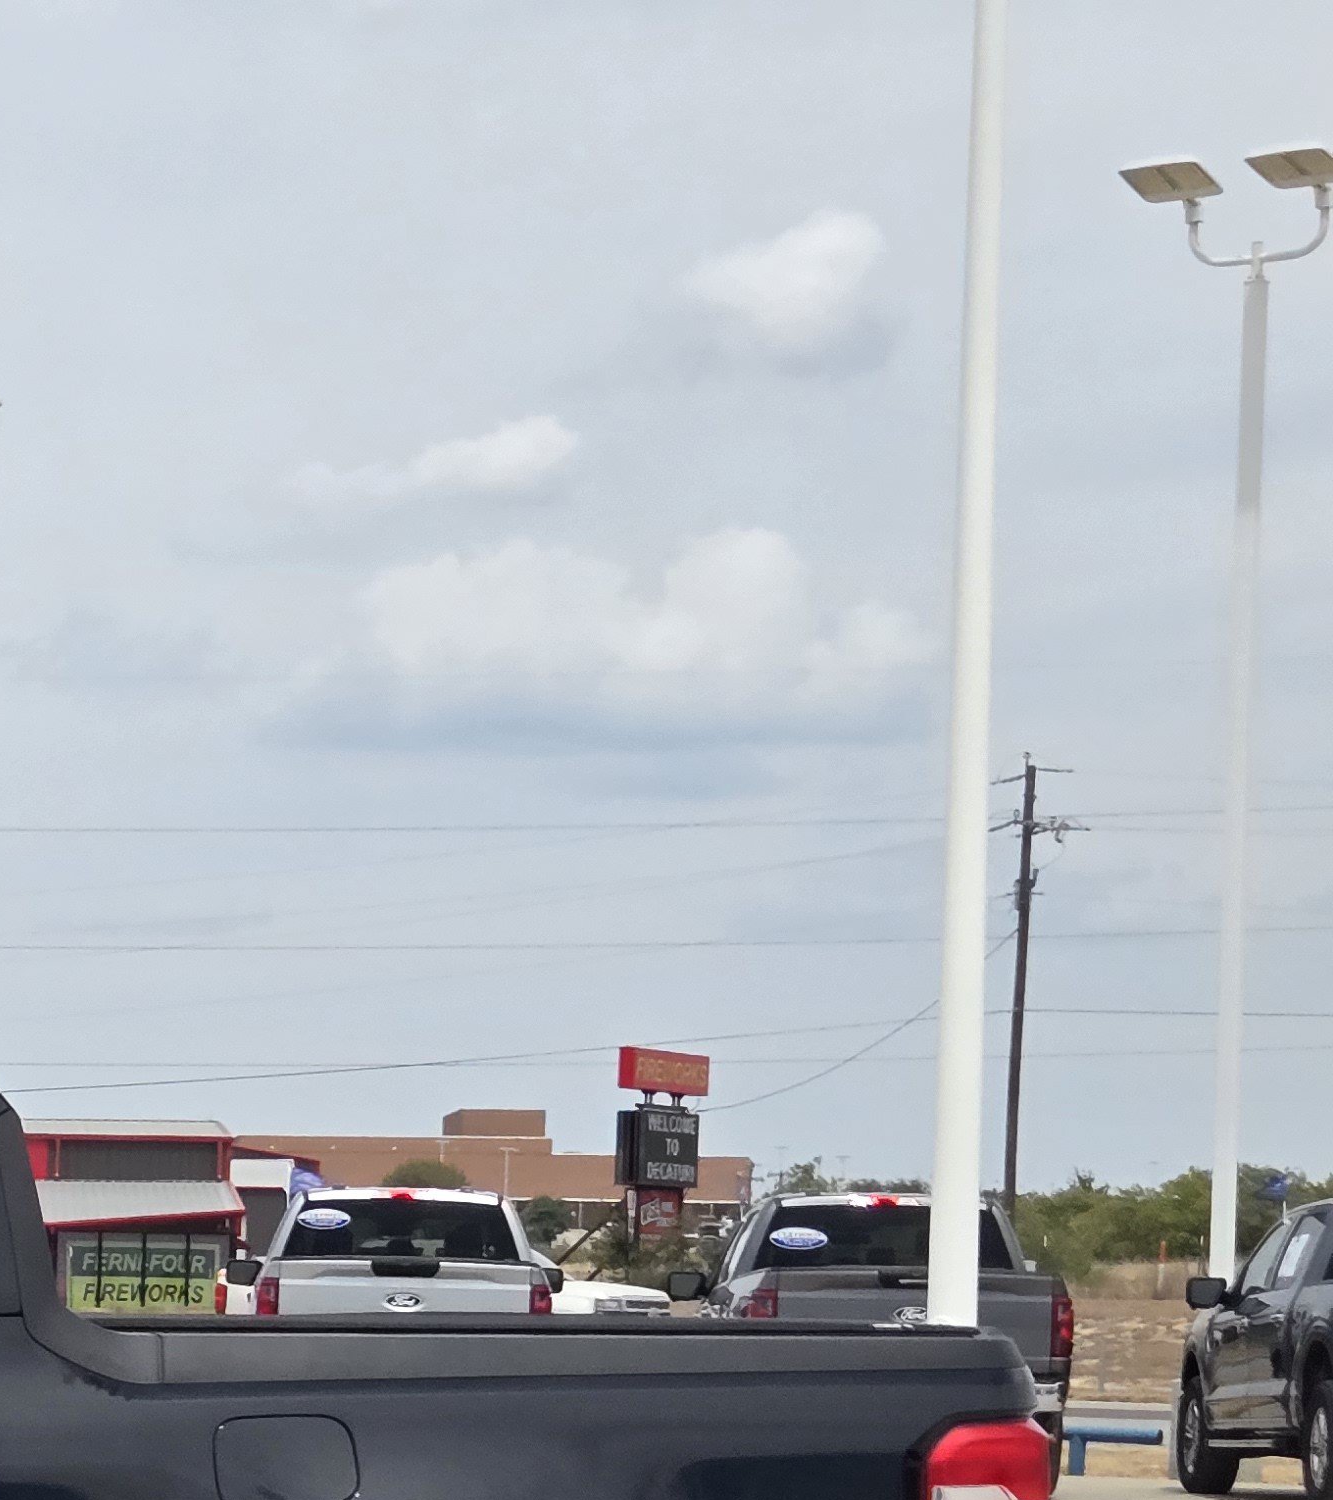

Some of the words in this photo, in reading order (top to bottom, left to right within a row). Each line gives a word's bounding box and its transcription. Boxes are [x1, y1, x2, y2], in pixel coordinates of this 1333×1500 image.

[648, 1114, 696, 1134] WELCOME
[665, 1137, 679, 1156] TO
[83, 1282, 204, 1304] FREWORKS
